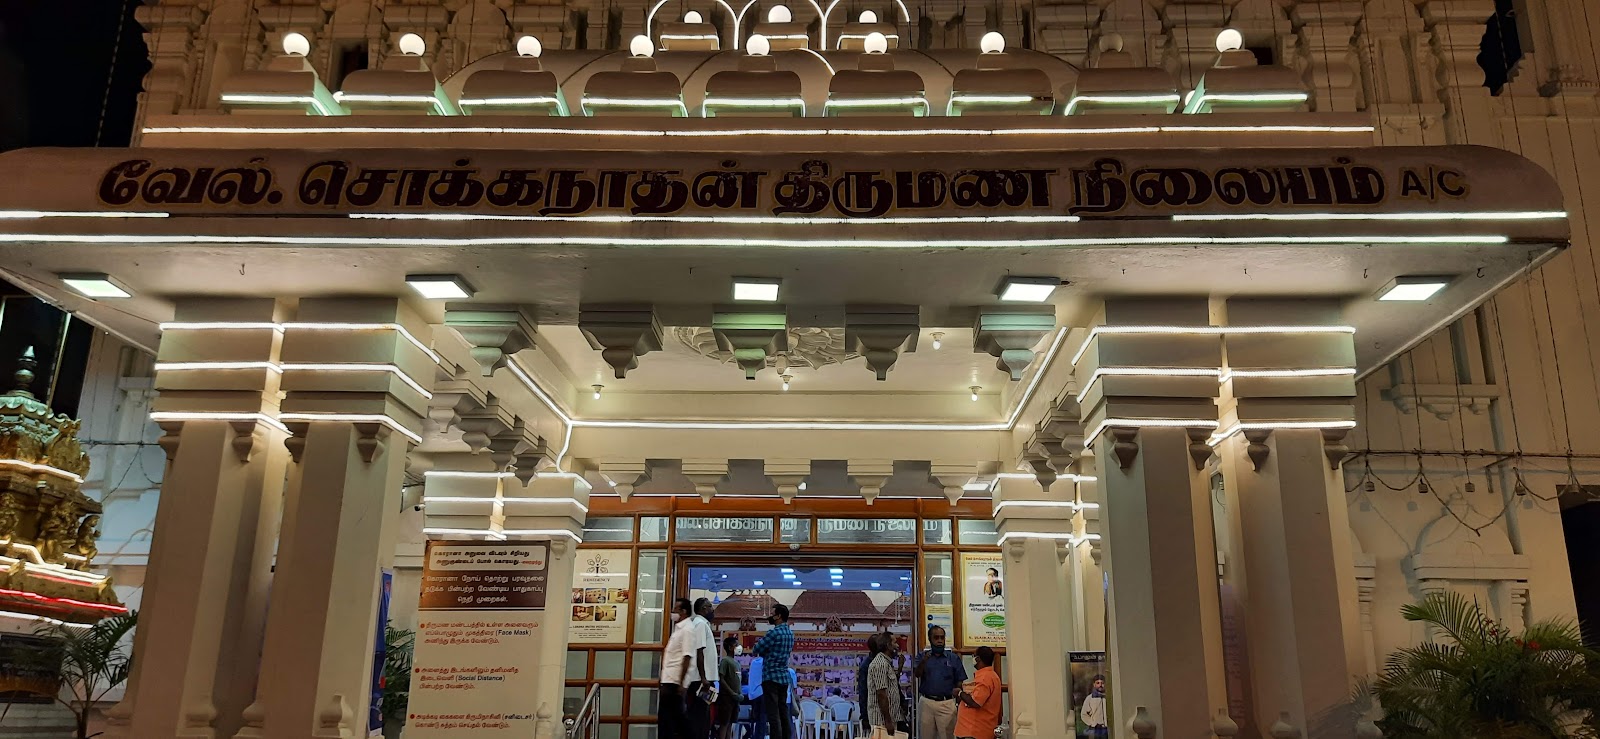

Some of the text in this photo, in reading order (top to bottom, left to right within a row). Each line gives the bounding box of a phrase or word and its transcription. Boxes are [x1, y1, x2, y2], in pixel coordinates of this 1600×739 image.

[99, 156, 1467, 217] வேல். சொக்கநாதன் திருமண நிலையம் A/C
